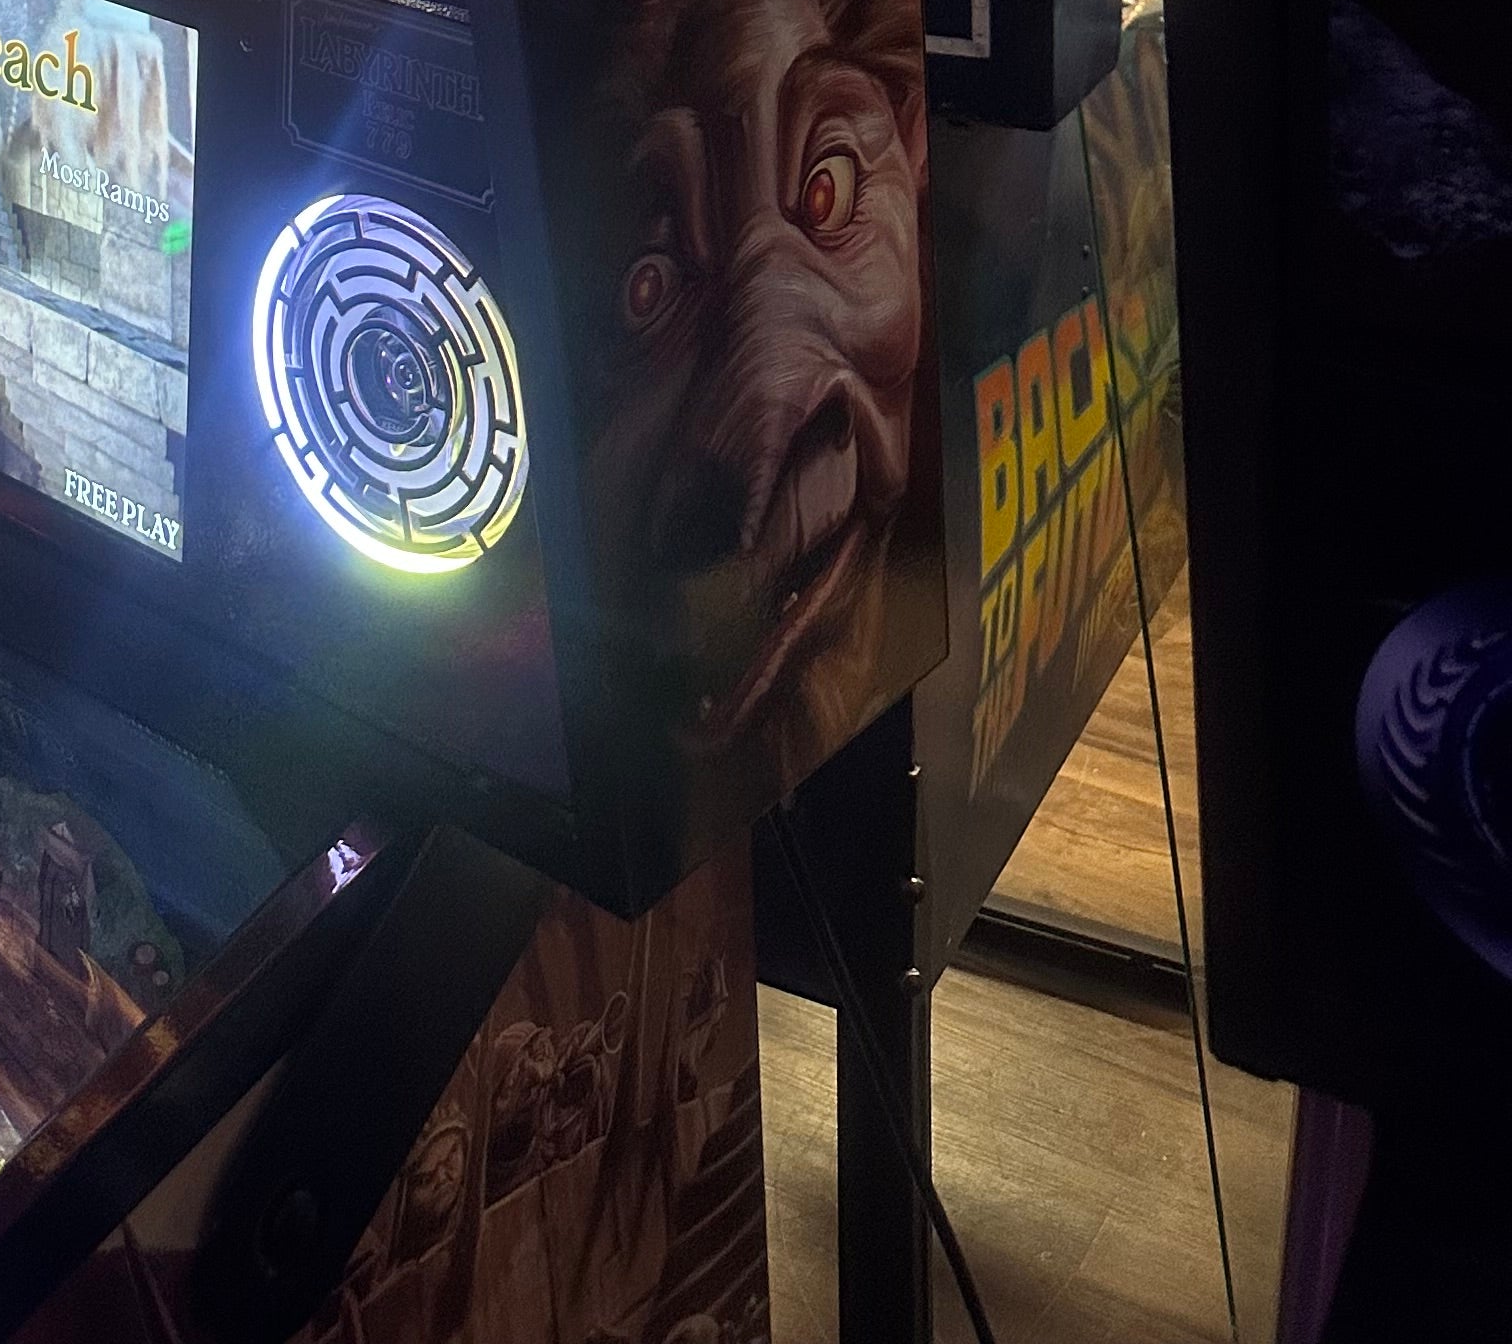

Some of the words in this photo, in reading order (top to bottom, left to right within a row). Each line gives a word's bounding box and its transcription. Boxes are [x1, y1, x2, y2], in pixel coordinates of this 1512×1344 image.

[299, 16, 485, 123] LABYRINTH
[39, 147, 93, 192] Most
[94, 168, 170, 223] Ramps
[64, 468, 119, 524] FREE
[119, 491, 181, 552] PLAY
